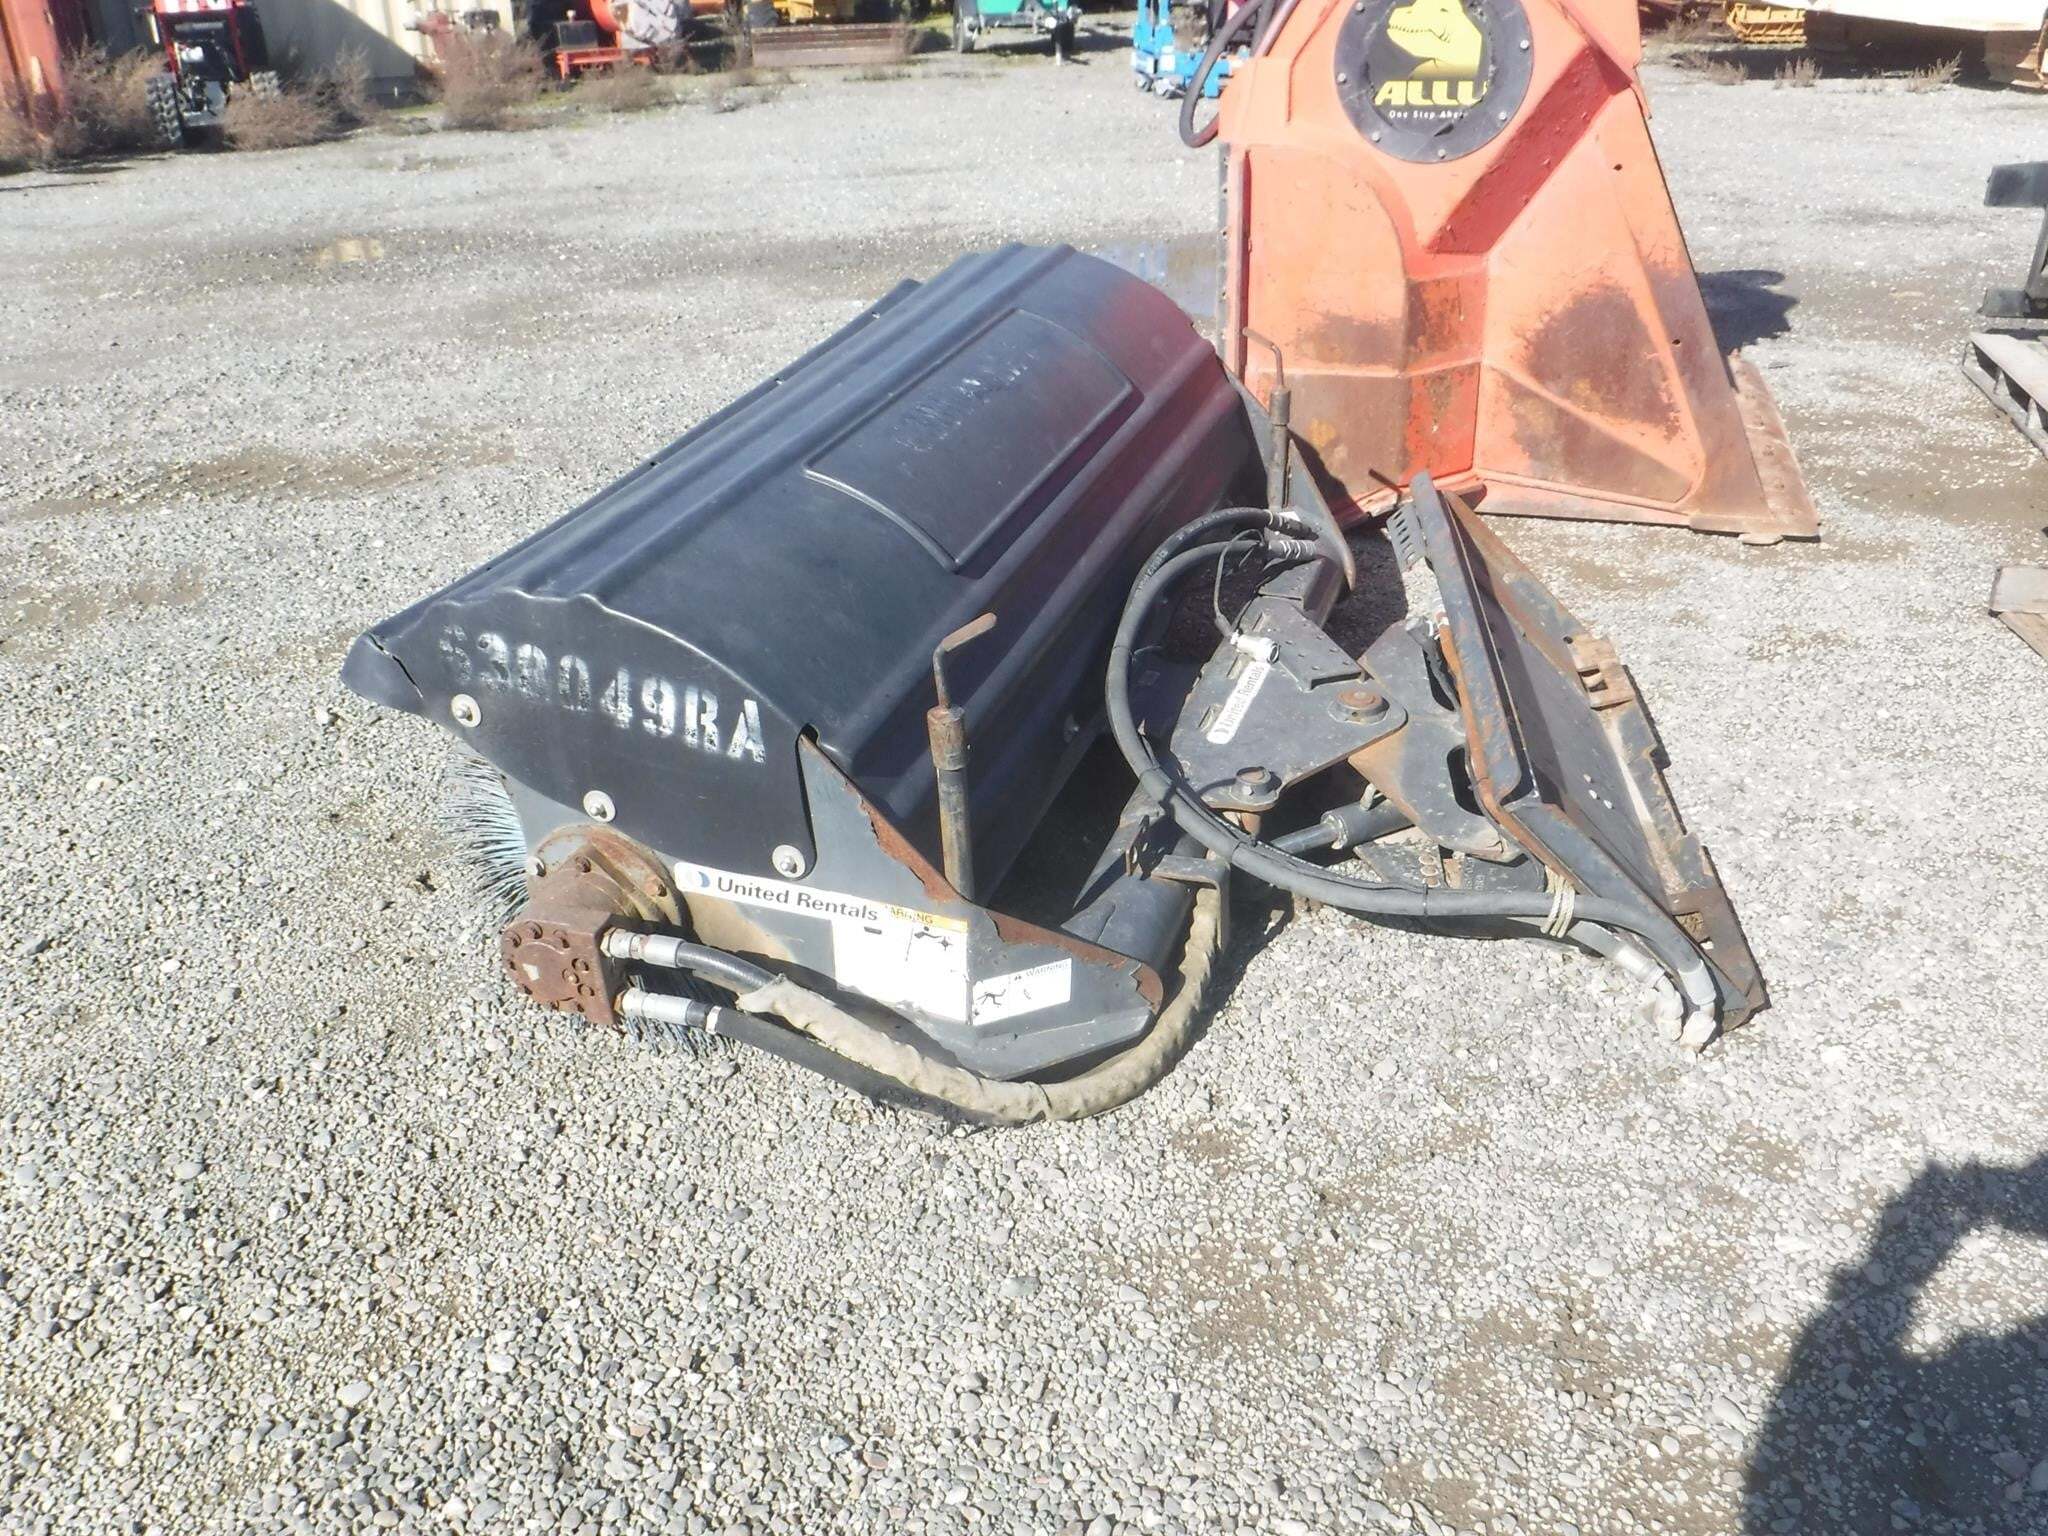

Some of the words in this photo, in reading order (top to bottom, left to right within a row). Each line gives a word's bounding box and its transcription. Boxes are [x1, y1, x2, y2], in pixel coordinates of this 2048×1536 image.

[1374, 80, 1487, 106] ALLU
[1389, 110, 1408, 119] One
[717, 877, 790, 904] United
[796, 892, 878, 921] Rentals
